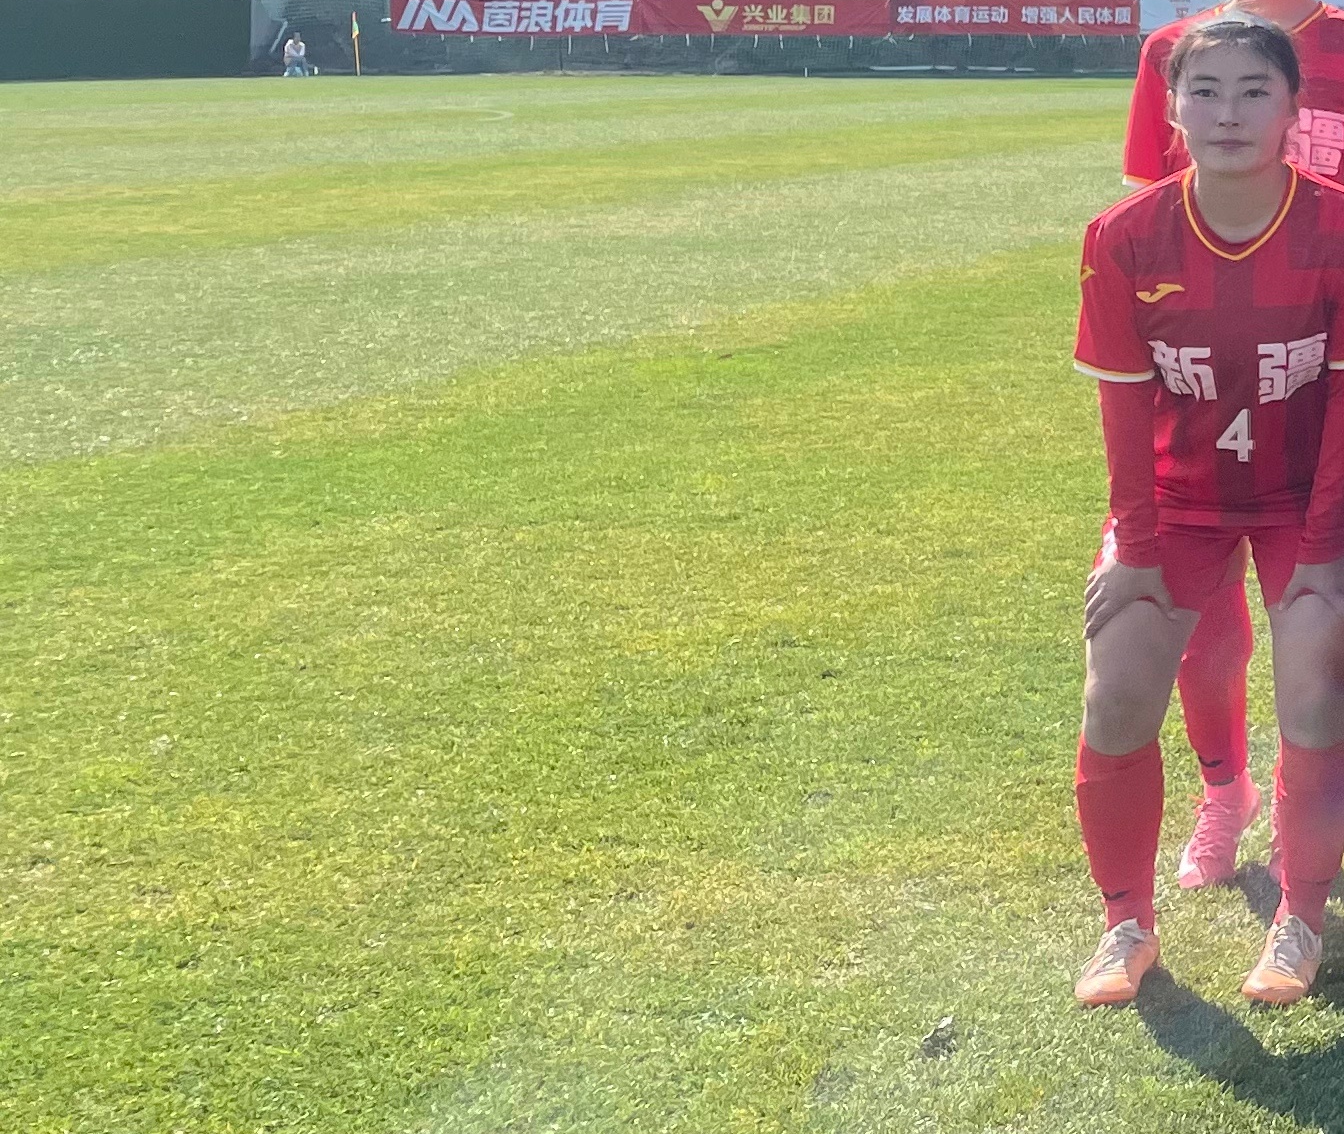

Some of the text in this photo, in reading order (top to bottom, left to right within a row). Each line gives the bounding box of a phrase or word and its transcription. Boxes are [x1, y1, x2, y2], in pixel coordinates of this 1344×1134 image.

[482, 0, 634, 32] 茵浪体育
[742, 4, 835, 24] 兴业集团
[897, 6, 1131, 24] 发展体育运动 增强人民体质
[1148, 332, 1328, 404] 新疆
[1216, 408, 1255, 463] 4
